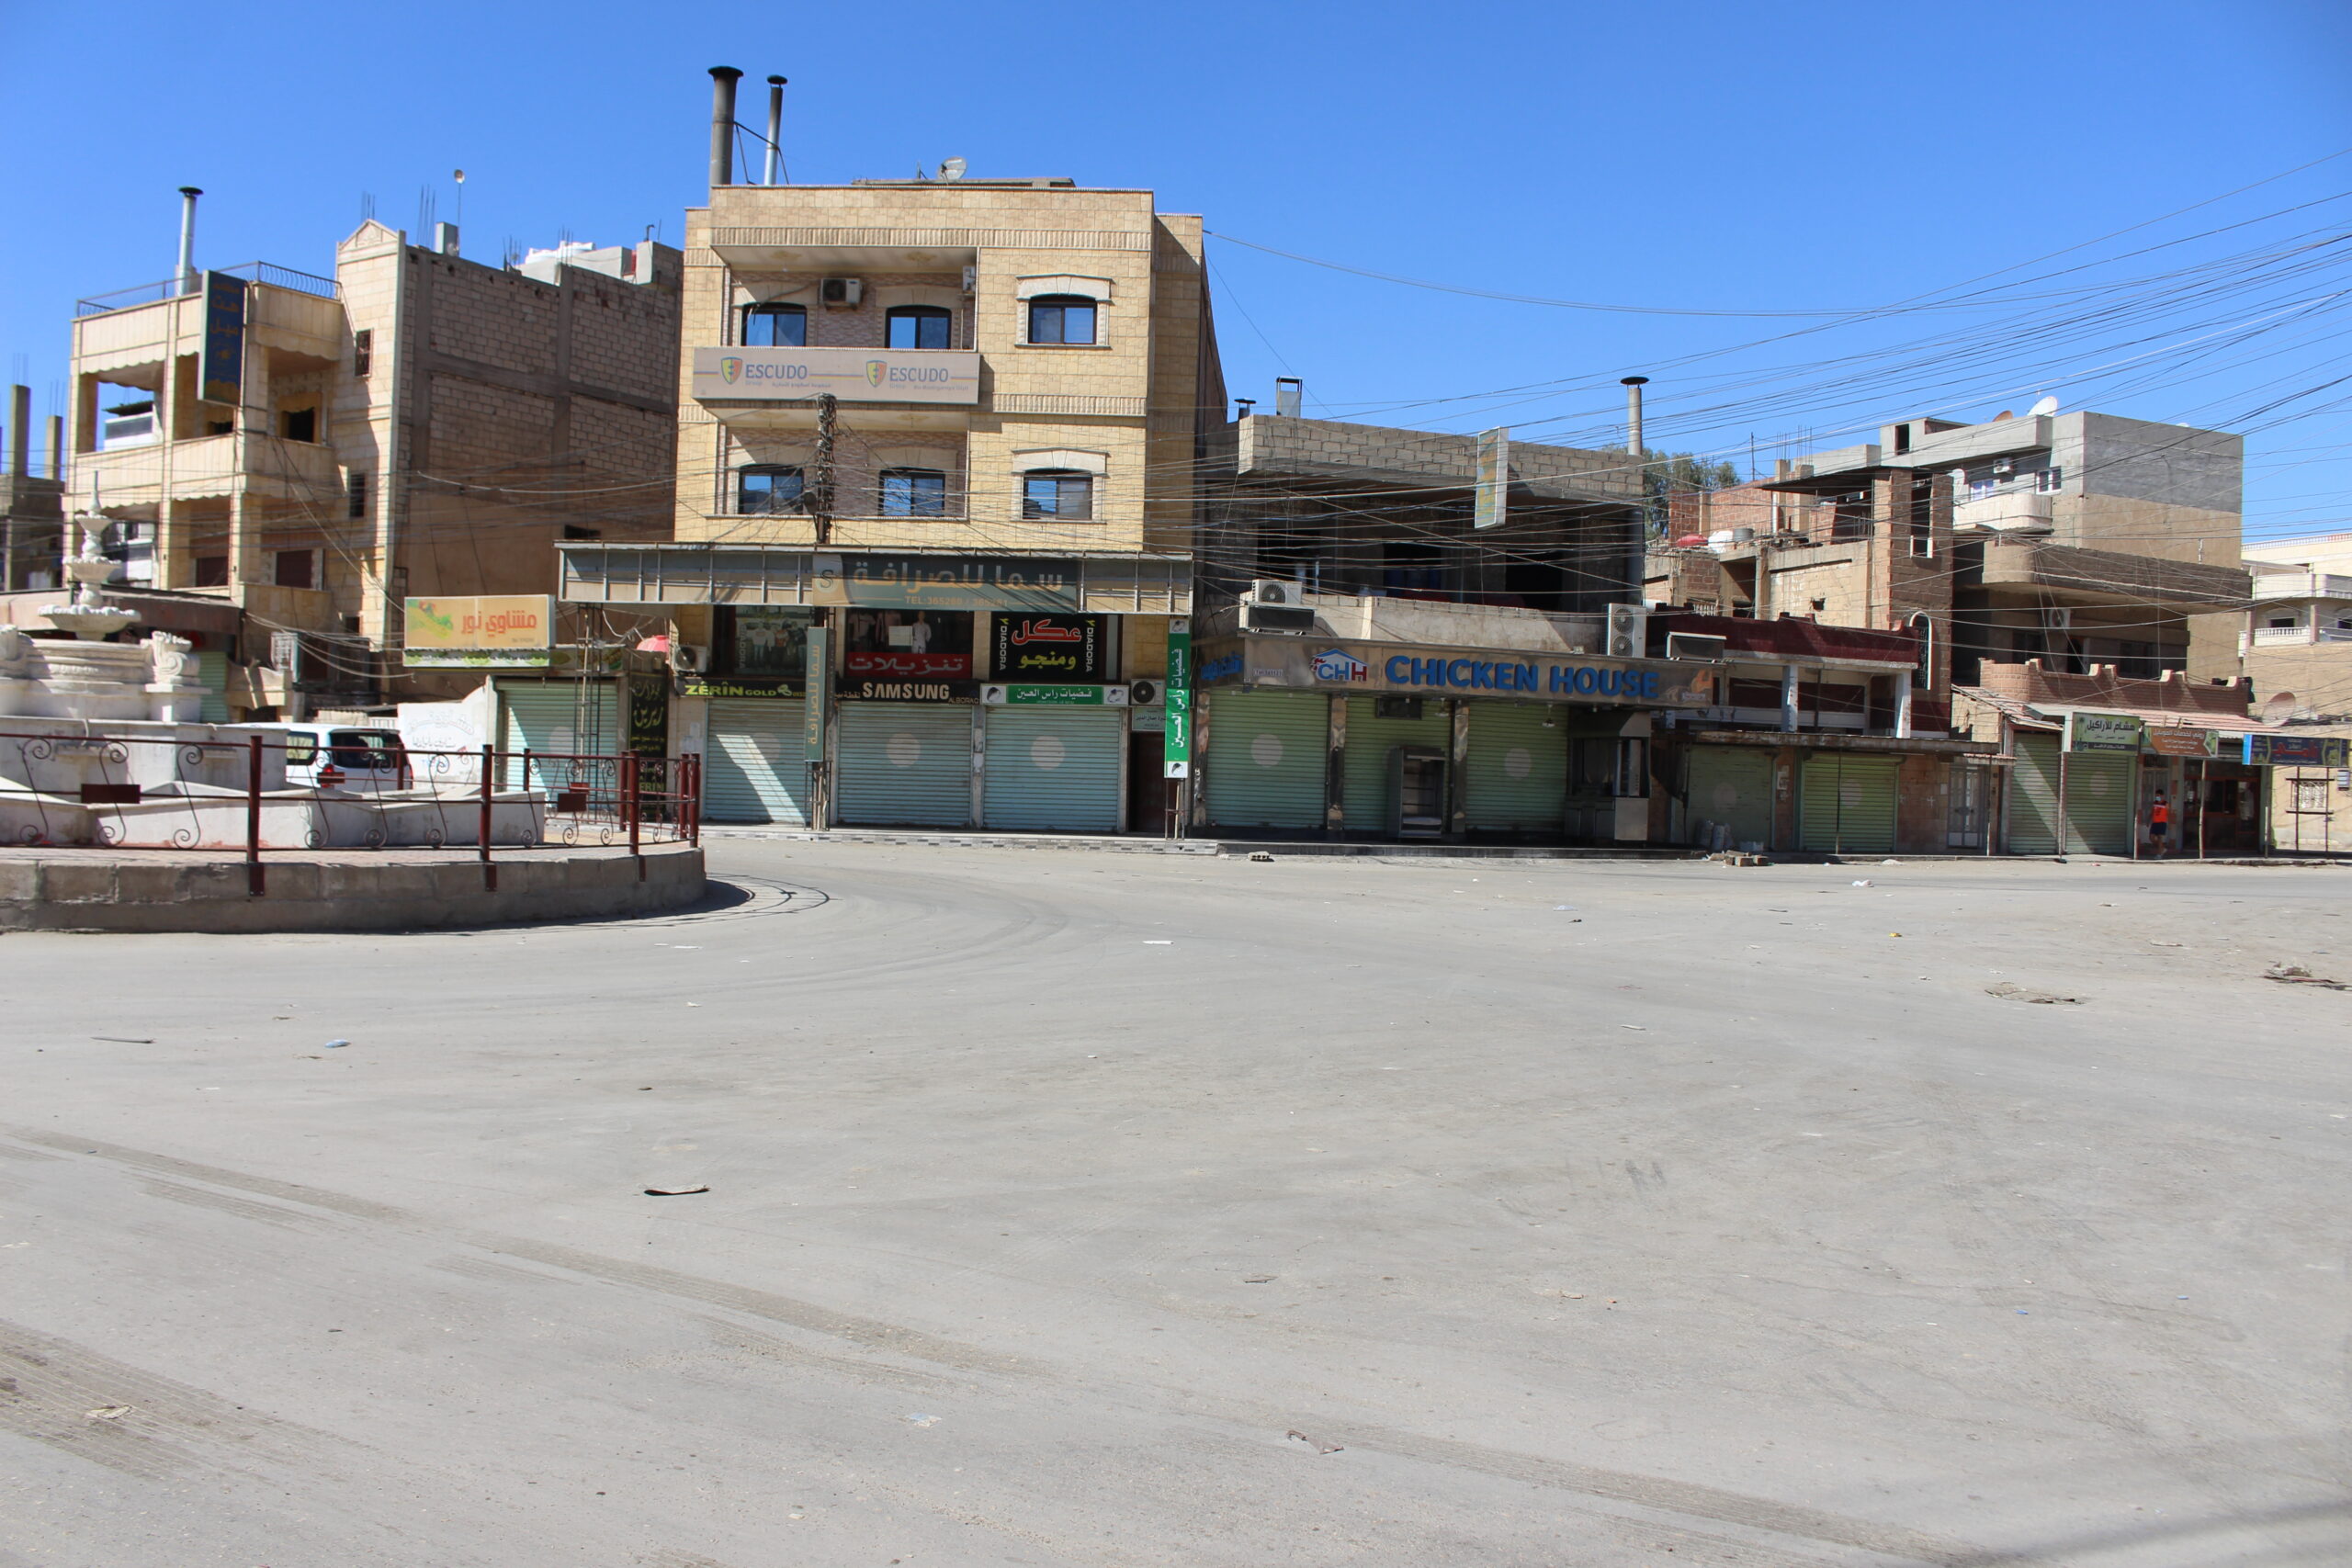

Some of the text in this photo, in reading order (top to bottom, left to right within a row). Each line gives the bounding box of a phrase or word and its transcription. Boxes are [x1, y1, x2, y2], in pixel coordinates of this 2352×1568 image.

[745, 364, 808, 379] ESCUDO
[889, 367, 948, 383] ESCUDO
[854, 561, 1062, 593] سما للصرافة
[461, 610, 537, 637] مشاوي نور
[1012, 618, 1082, 645] عكل
[1000, 626, 1008, 671] DIADORA
[1086, 627, 1094, 671] DIADORA
[849, 657, 964, 675] تنزيلات
[1170, 648, 1185, 688] فضيات
[1317, 661, 1367, 682] CHH
[1385, 655, 1659, 698] CHICKEN HOUSE
[808, 645, 821, 745] سما للصرافة
[863, 682, 950, 700] SAMSUNG
[1017, 688, 1040, 699] العين
[1060, 688, 1091, 700] فضيات
[1171, 713, 1185, 749] العين
